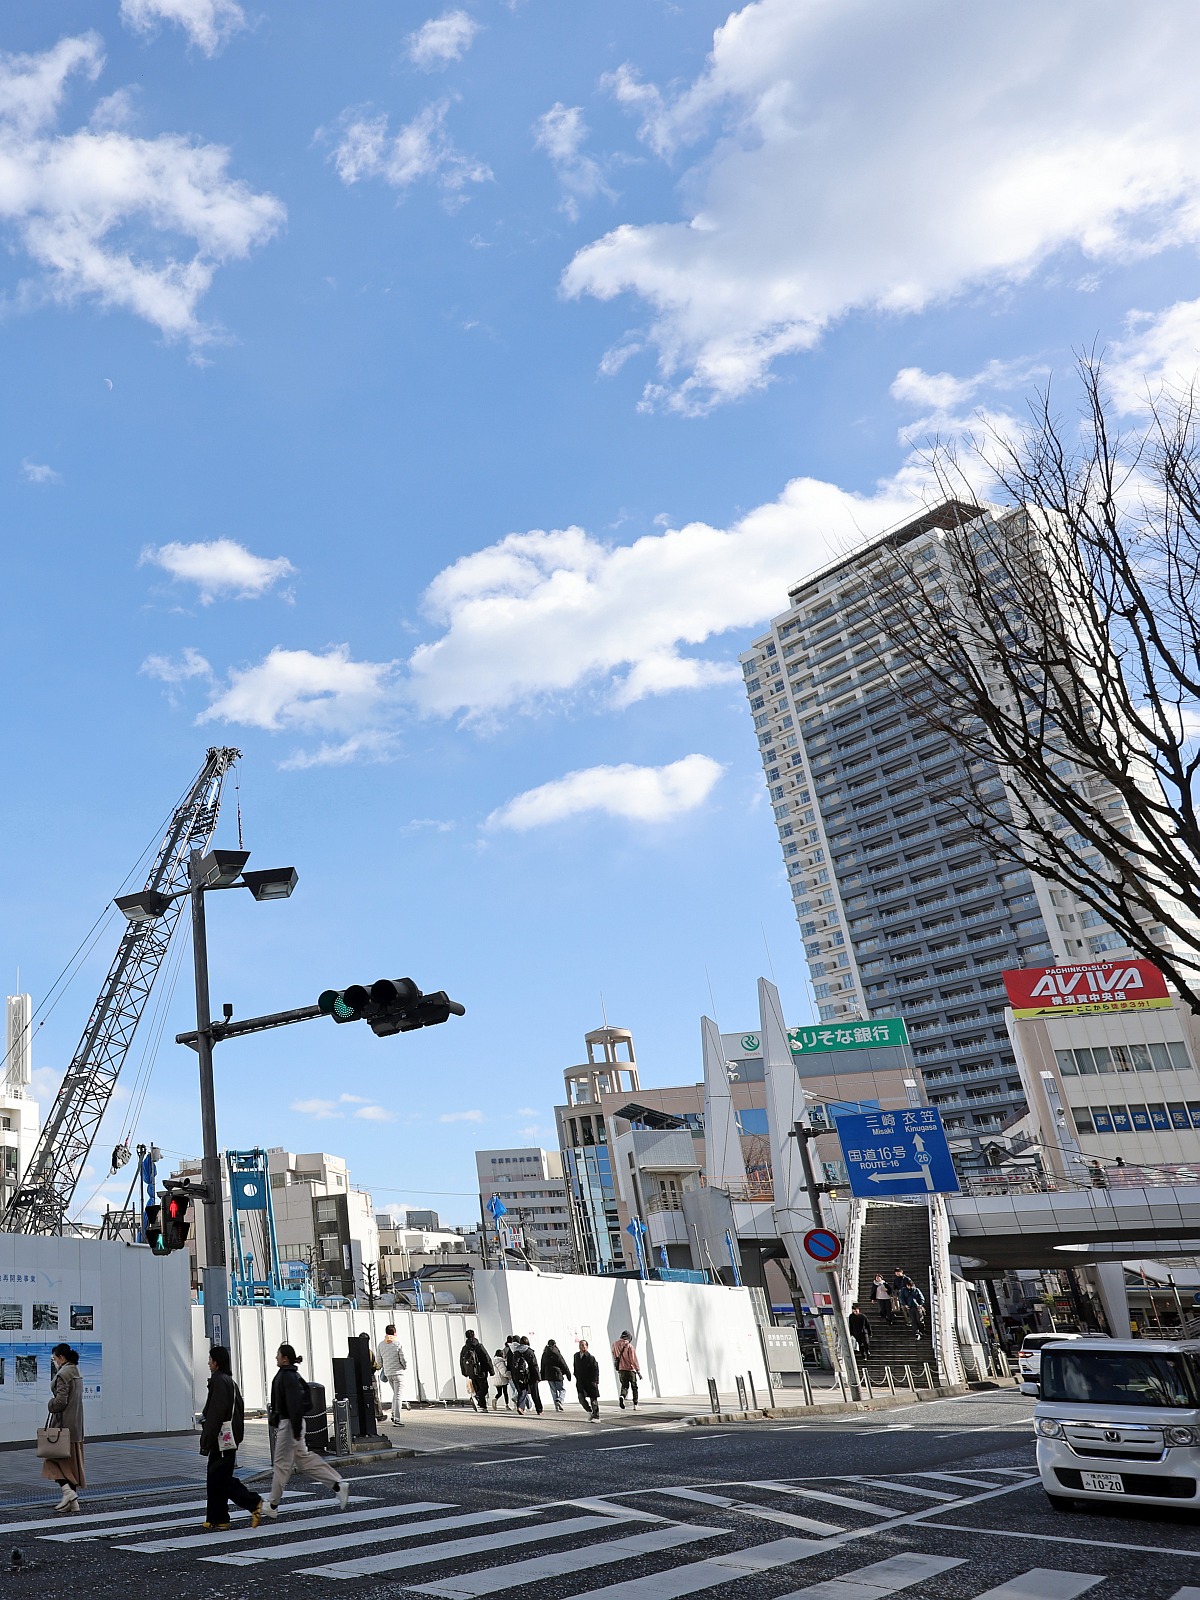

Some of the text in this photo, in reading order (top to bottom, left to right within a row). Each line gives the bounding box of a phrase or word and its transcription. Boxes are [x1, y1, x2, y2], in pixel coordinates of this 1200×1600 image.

[1044, 963, 1114, 976] PACHINKO&SLOT
[1029, 967, 1144, 998] AVIVA
[1051, 991, 1127, 1006] 横須賀中央店
[803, 1025, 890, 1048] りそな銀行
[865, 1110, 936, 1128] 三崎 衣笠
[872, 1125, 938, 1135] Misaki Kinugasa
[848, 1145, 907, 1163] 国道16号
[917, 1154, 929, 1163] 26
[860, 1160, 900, 1170] ROUTE-16
[501, 1230, 508, 1246] 1
[1092, 1480, 1122, 1491] 10-20
